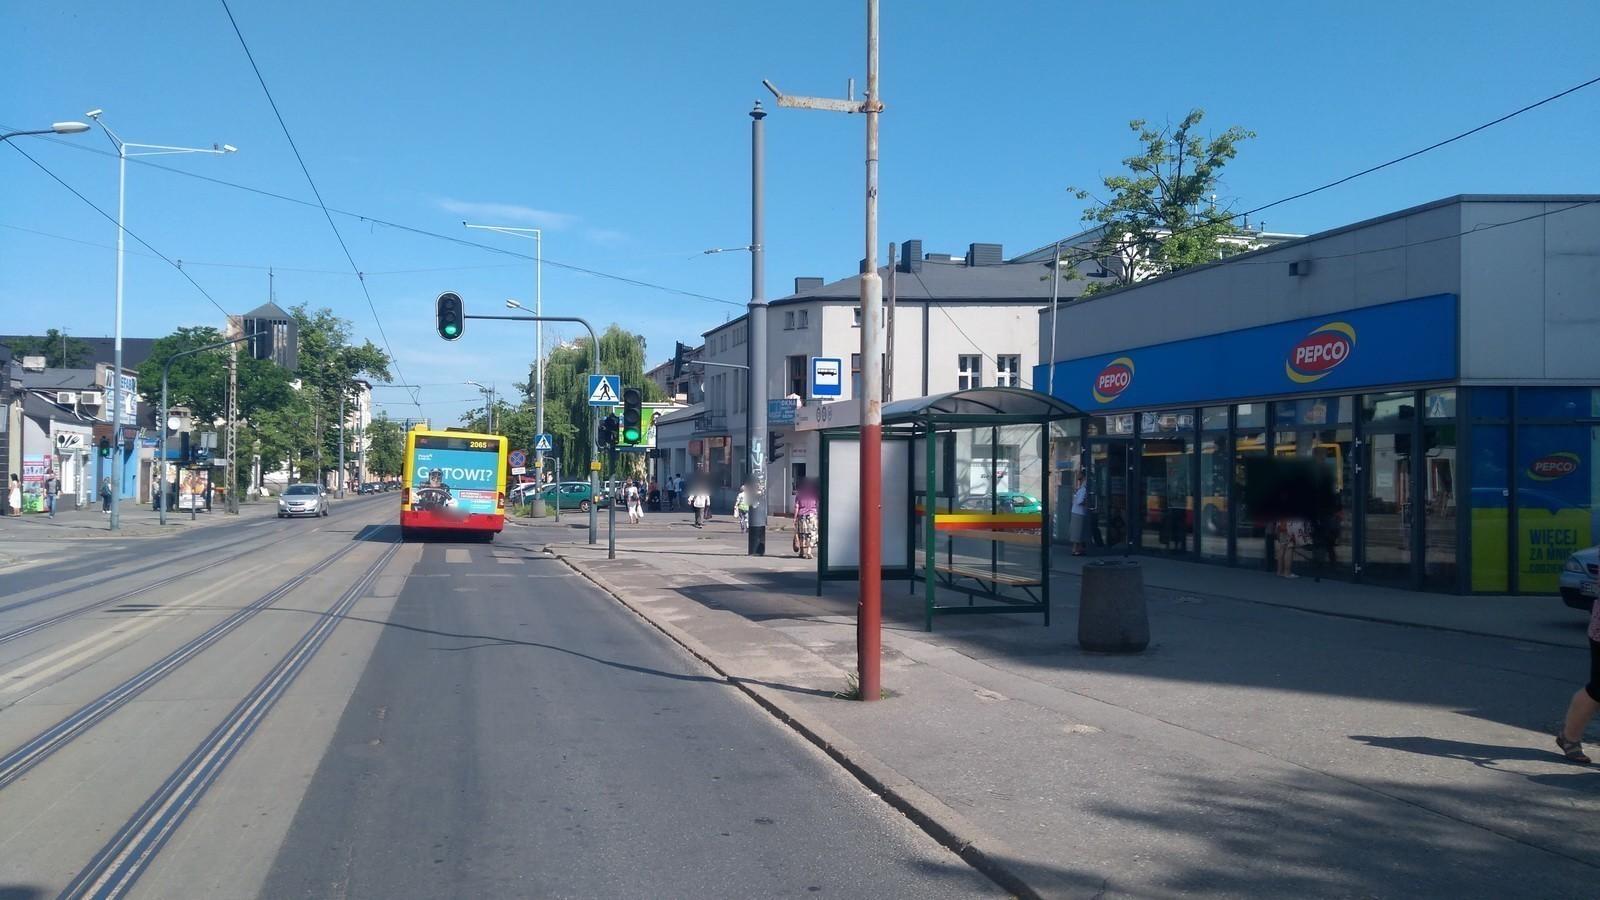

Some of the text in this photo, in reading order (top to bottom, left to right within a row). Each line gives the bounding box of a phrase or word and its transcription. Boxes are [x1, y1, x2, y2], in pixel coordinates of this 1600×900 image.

[1296, 341, 1345, 365] PEPCO
[1099, 372, 1128, 389] PEPCO
[470, 441, 487, 449] 2065
[417, 466, 493, 481] GTOWI?
[1535, 462, 1573, 473] PEPCO
[1528, 528, 1577, 546] WIĘCEJ
[1528, 547, 1577, 561] ZA MNIE
